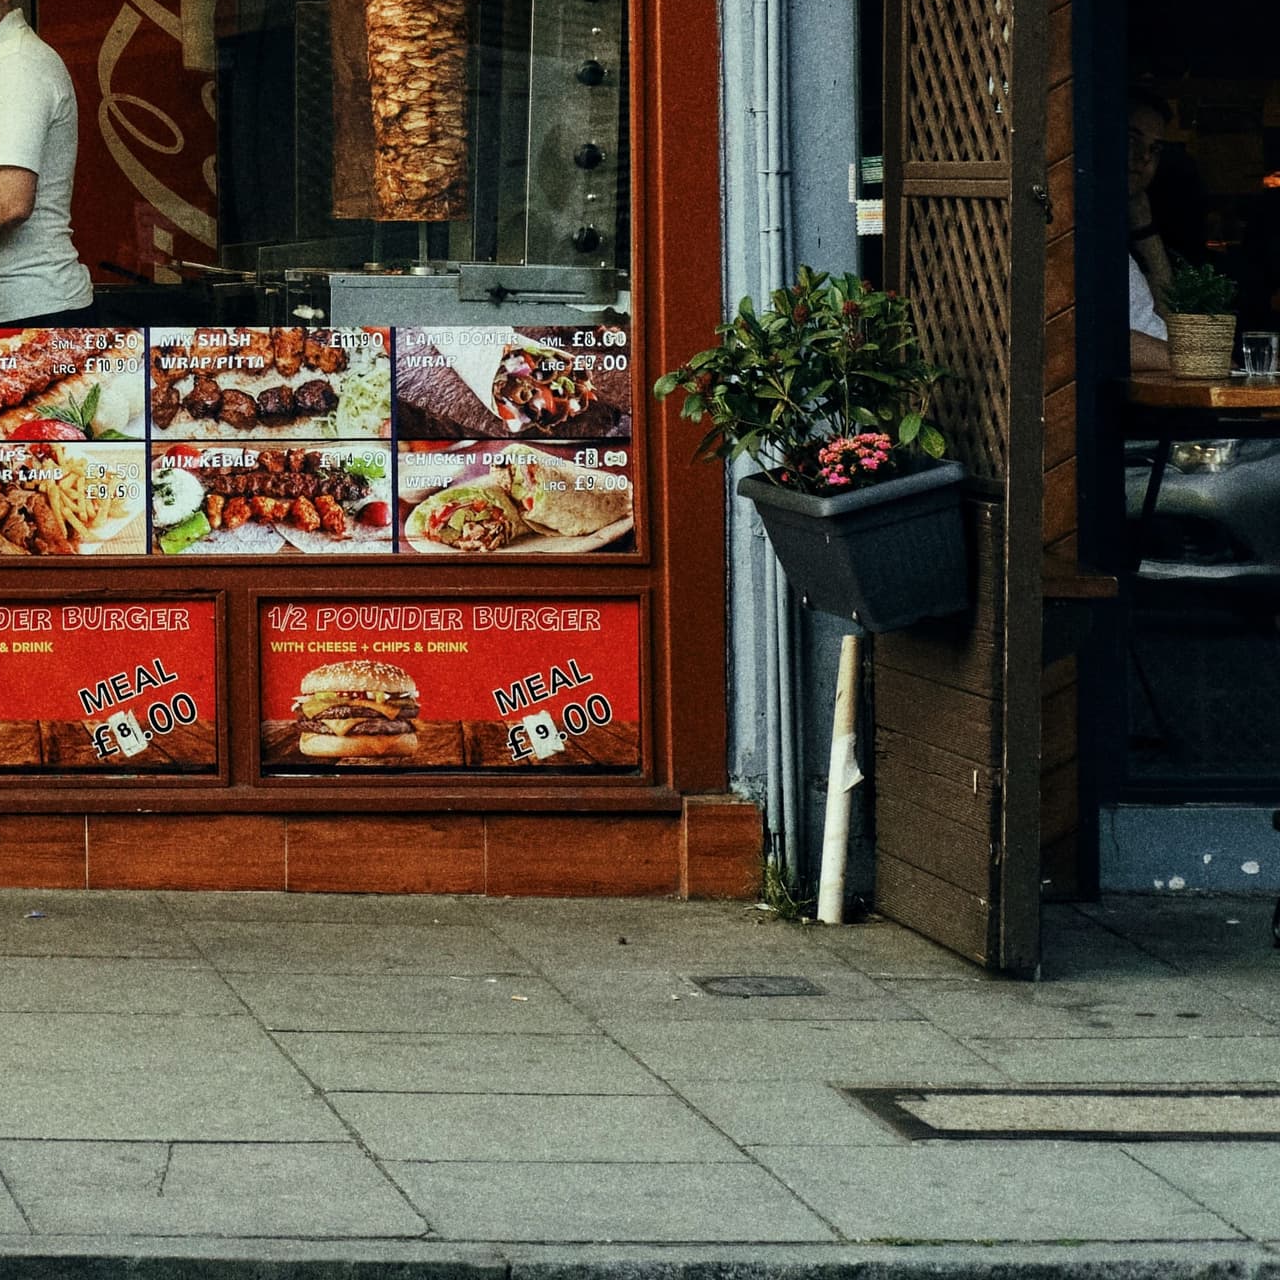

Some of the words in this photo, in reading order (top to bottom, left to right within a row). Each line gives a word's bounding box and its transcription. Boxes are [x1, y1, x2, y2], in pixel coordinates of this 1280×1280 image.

[84, 334, 138, 349] £8.50
[160, 335, 193, 347] MIX
[198, 333, 251, 347] SHISH
[406, 332, 454, 346] LAMB
[460, 332, 519, 345] DONER
[540, 337, 565, 347] SML
[160, 355, 265, 369] WRAP/PITTA
[406, 355, 457, 368] WRAP
[541, 361, 565, 371] LRG
[573, 355, 627, 371] £9.00
[53, 364, 76, 374] LRG
[161, 454, 194, 467] MIX
[199, 454, 257, 467] KEBAB
[320, 452, 386, 468] £14.90
[405, 452, 476, 465] CHICKEN
[482, 452, 538, 465] DONER
[18, 468, 64, 481] LAMB
[406, 476, 453, 488] WRAP
[543, 481, 567, 491] LRG
[574, 474, 628, 490] £9.00
[62, 606, 190, 631] BURGER
[268, 603, 308, 632] 1/2
[316, 606, 464, 631] POUNDER
[473, 606, 601, 631] BURGER
[0, 642, 9, 653] &
[12, 641, 54, 653] DRINK
[270, 642, 305, 653] WITH
[307, 642, 358, 653] CHEESE
[372, 642, 411, 653] CHIPS
[414, 641, 424, 653] &
[427, 641, 469, 653] DRINK
[78, 658, 178, 716] MEAL
[493, 658, 594, 717] MEAL
[93, 692, 198, 760] £8.00
[506, 693, 613, 762] £9.00
